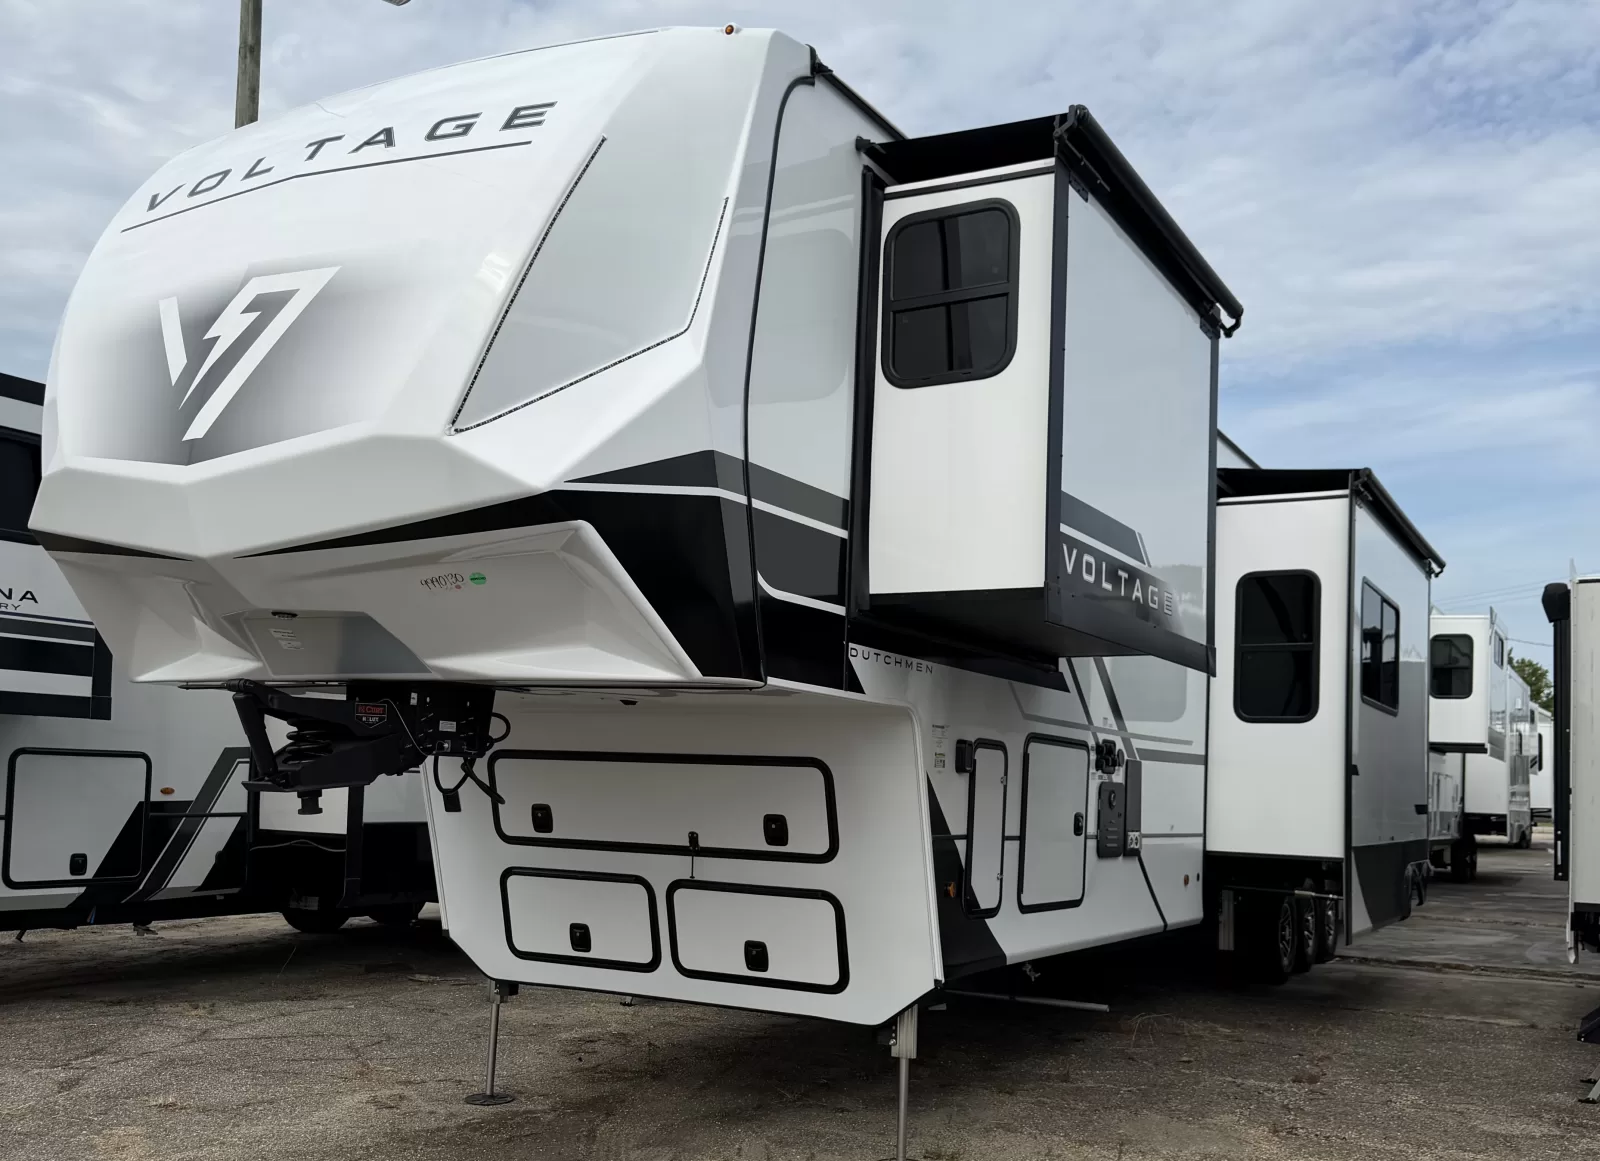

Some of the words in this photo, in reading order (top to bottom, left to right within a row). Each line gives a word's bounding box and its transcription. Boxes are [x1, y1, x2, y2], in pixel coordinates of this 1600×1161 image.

[146, 101, 558, 212] VOLTAGE
[1062, 543, 1173, 616] VOLTAGE
[849, 647, 933, 674] DUTCHMEN
